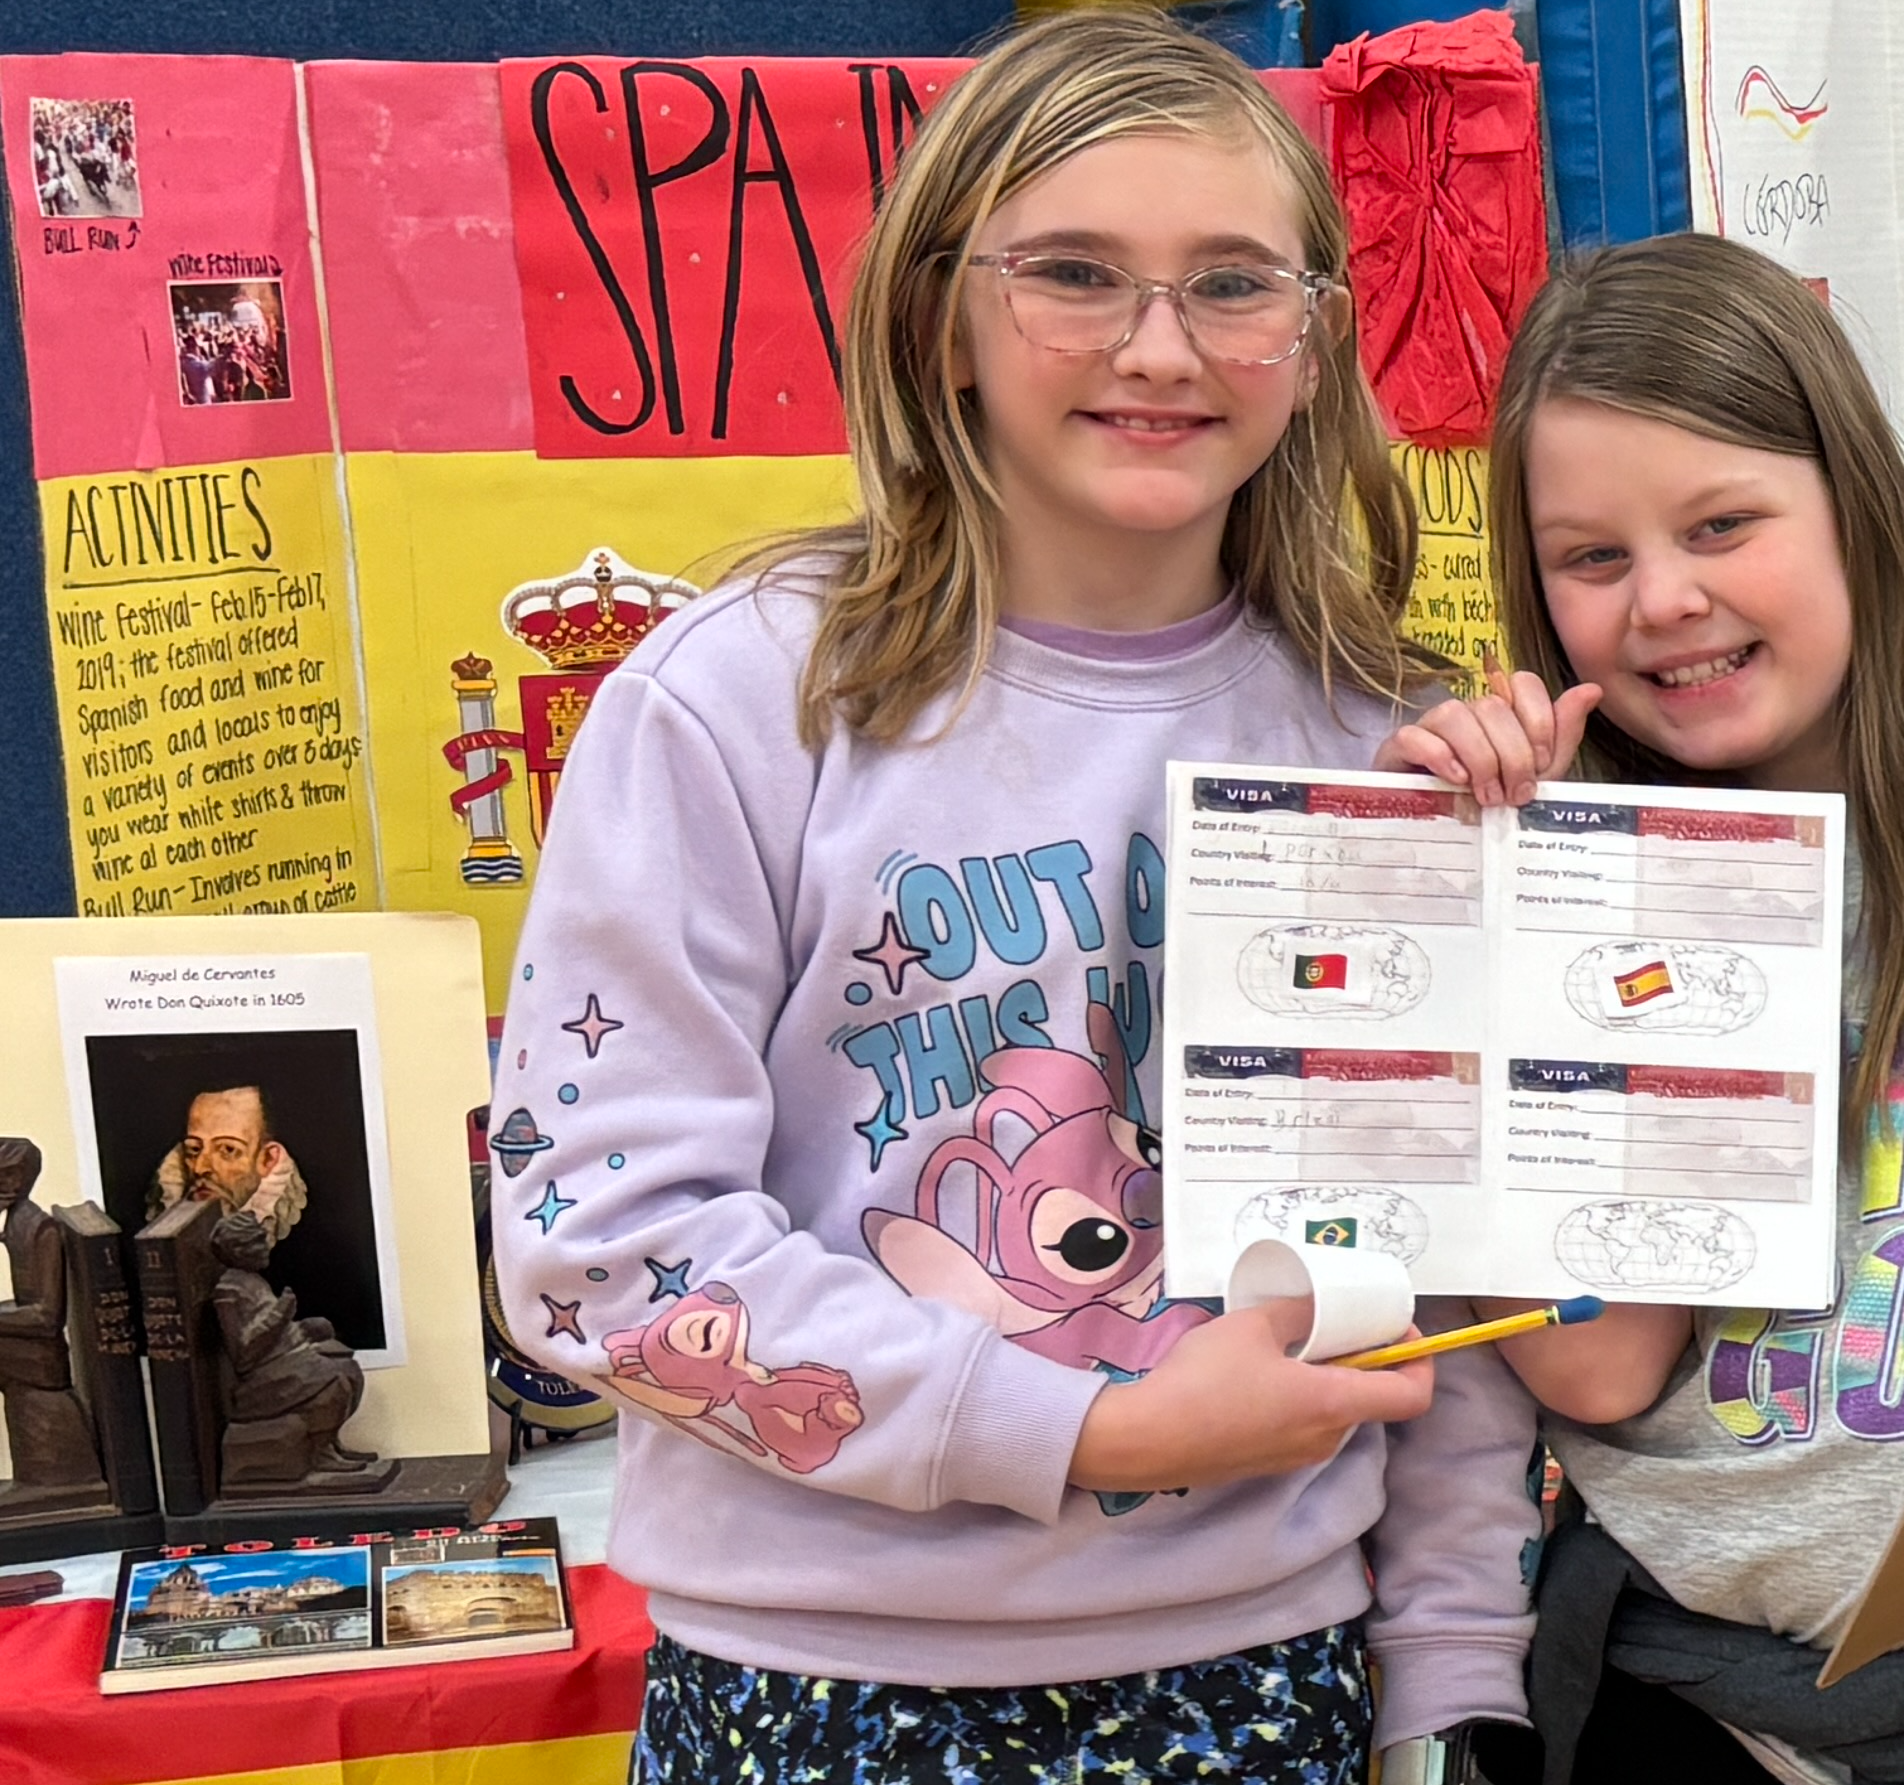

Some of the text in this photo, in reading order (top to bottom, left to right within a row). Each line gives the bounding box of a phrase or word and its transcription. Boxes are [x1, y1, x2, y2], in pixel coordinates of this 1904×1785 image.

[43, 226, 121, 254] BULL RUN
[530, 60, 925, 440] SPA
[1388, 441, 1483, 534] OODS
[63, 467, 273, 574] ACTIVITIES
[130, 647, 160, 679] the
[237, 616, 299, 657] offered
[77, 657, 326, 745] Spanish food and wine for
[82, 738, 154, 780] visitors
[167, 718, 208, 756] and
[276, 703, 296, 729] to
[299, 697, 342, 738] enjoy
[83, 795, 96, 818] a
[176, 762, 194, 789] of
[202, 751, 256, 785] events
[263, 744, 299, 770] over
[1225, 787, 1274, 803] VISA
[85, 823, 121, 860] you
[127, 812, 171, 836] wear
[280, 782, 295, 810] &
[1551, 808, 1603, 825] VISA
[92, 853, 134, 883] wine
[165, 835, 208, 866] each
[211, 827, 259, 857] other
[267, 852, 333, 885] running
[335, 845, 353, 872] in
[896, 831, 1166, 982] OUT O
[104, 992, 306, 1011] Wrote Don Quixote in 1605
[129, 967, 276, 986] Miguel de Cervantes
[841, 978, 1056, 1123] THIS
[1217, 1054, 1268, 1068] VISA
[1540, 1068, 1591, 1083] VISA
[159, 1519, 528, 1560] TOLEDO
